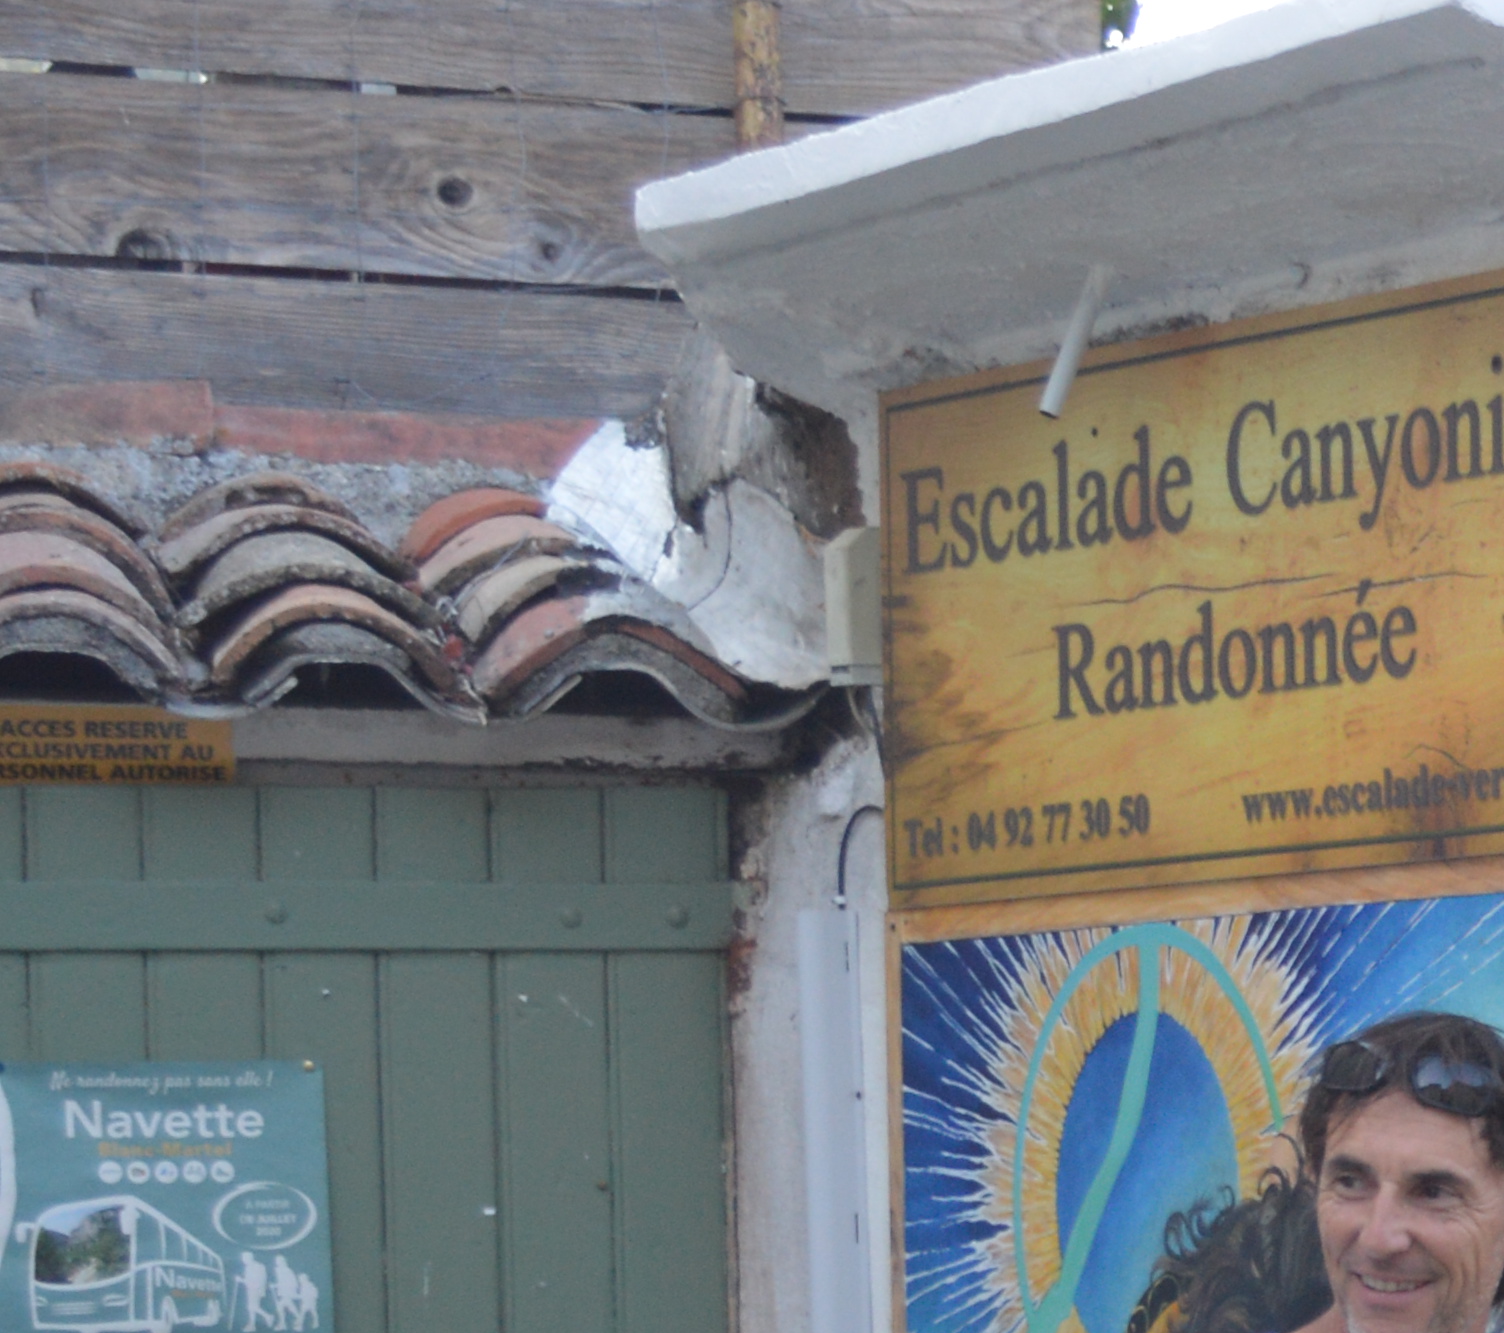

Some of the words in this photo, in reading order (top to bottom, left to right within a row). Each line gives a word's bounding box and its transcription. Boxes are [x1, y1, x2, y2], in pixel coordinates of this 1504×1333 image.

[900, 425, 1194, 575] Escalade
[1051, 580, 1418, 720] Randonnée
[1, 719, 76, 738] ACCES
[84, 720, 187, 739] RESERVE
[180, 745, 214, 761] AU
[111, 764, 227, 781] AUTORISE
[904, 817, 943, 857] Tel
[967, 810, 996, 850] 04
[1004, 806, 1034, 846] 92
[1041, 802, 1072, 844] 77
[1079, 797, 1111, 841] 30
[1118, 793, 1149, 836] 50
[64, 1100, 265, 1138] Navette
